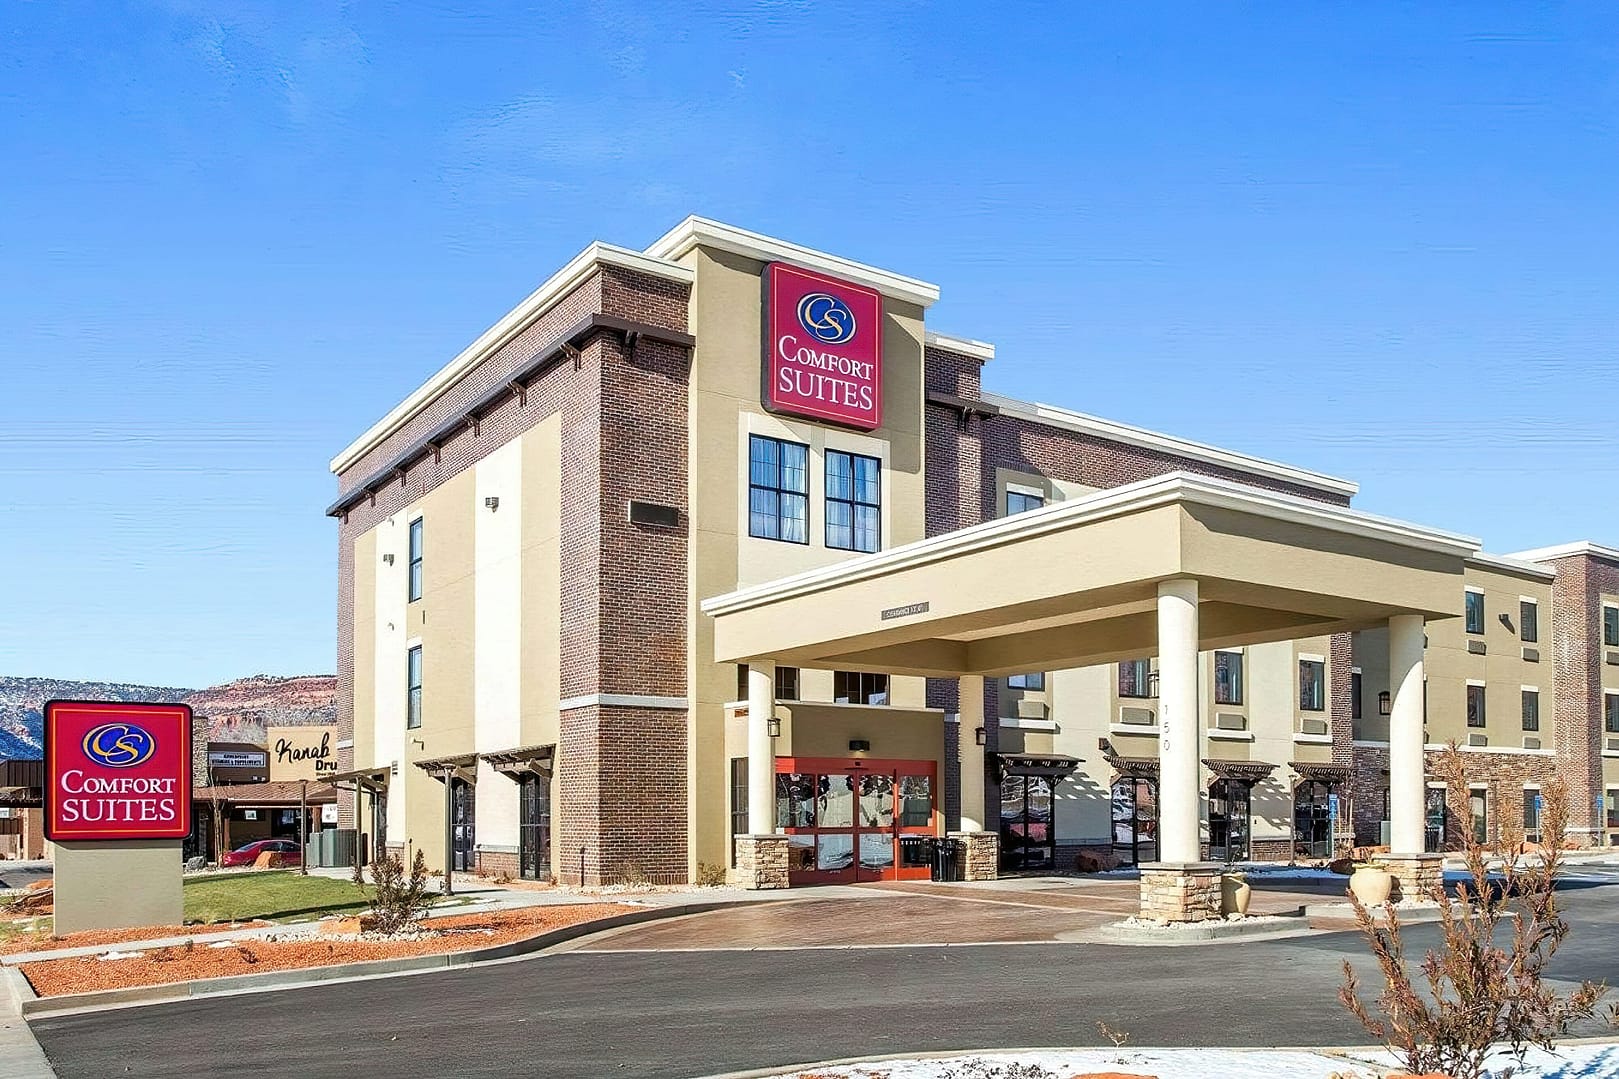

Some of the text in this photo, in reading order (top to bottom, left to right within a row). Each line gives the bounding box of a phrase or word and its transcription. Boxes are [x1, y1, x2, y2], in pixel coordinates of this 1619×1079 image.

[778, 335, 874, 381] COMFORT
[779, 366, 873, 411] SUITES
[1163, 704, 1171, 751] 150
[275, 731, 331, 764] Kanab
[60, 769, 177, 794] COMFORT
[61, 798, 176, 822] SUITES
